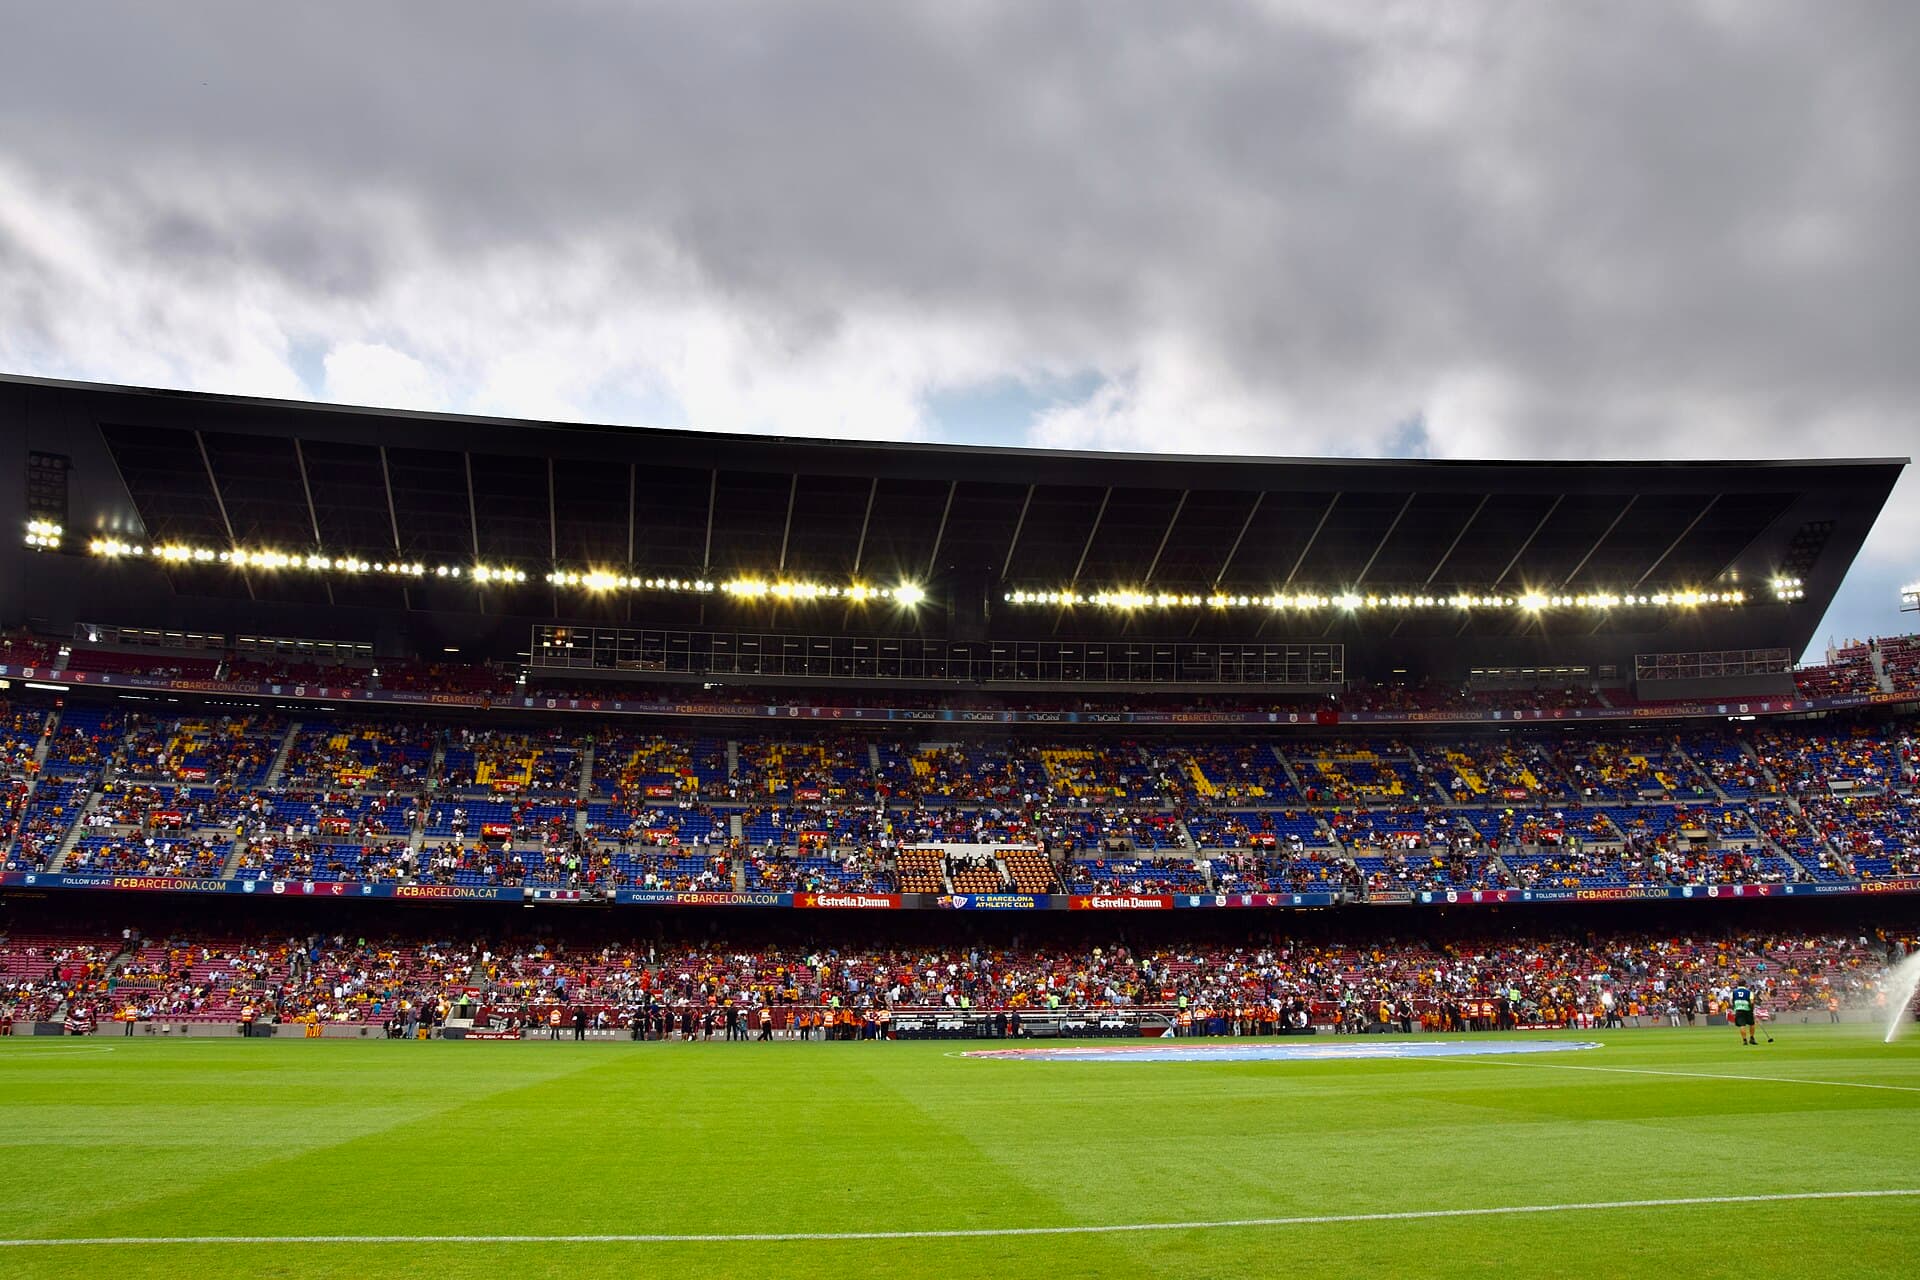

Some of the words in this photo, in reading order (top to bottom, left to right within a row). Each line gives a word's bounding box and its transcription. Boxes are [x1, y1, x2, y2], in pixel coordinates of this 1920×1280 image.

[114, 878, 226, 890] FCBARCELONA.COM
[396, 887, 499, 898] FCBARCELONA.CAT
[1577, 889, 1669, 899] FCBARCELONA.COM
[677, 893, 778, 904] FCBARCELONA.COM
[817, 895, 856, 907] Estrella
[857, 896, 890, 907] Damm
[1092, 897, 1130, 908] Estrella
[1130, 898, 1162, 908] Damm
